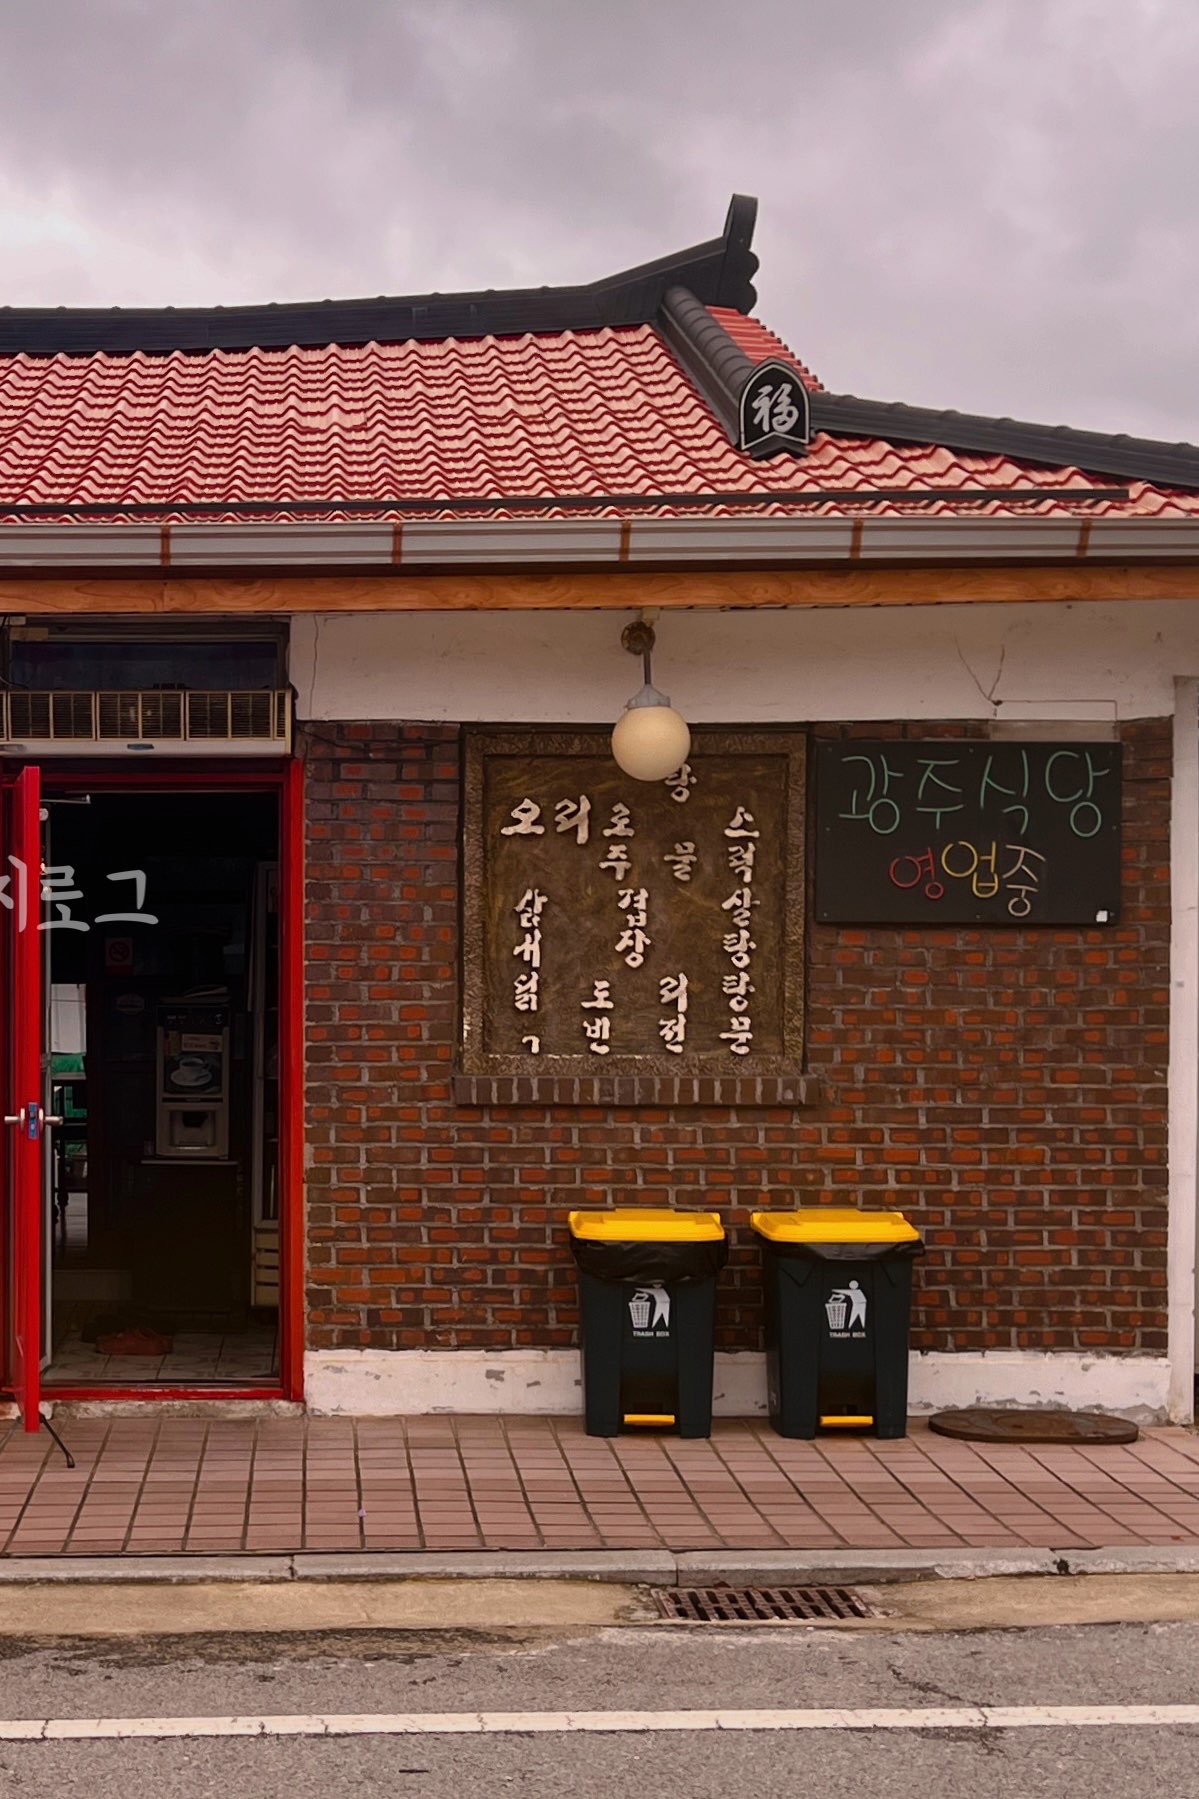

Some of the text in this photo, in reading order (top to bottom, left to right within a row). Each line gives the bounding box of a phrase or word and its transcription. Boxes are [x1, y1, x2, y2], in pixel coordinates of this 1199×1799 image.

[752, 383, 799, 433] 福
[839, 750, 1110, 837] 광주식당
[889, 841, 1046, 917] 영업중
